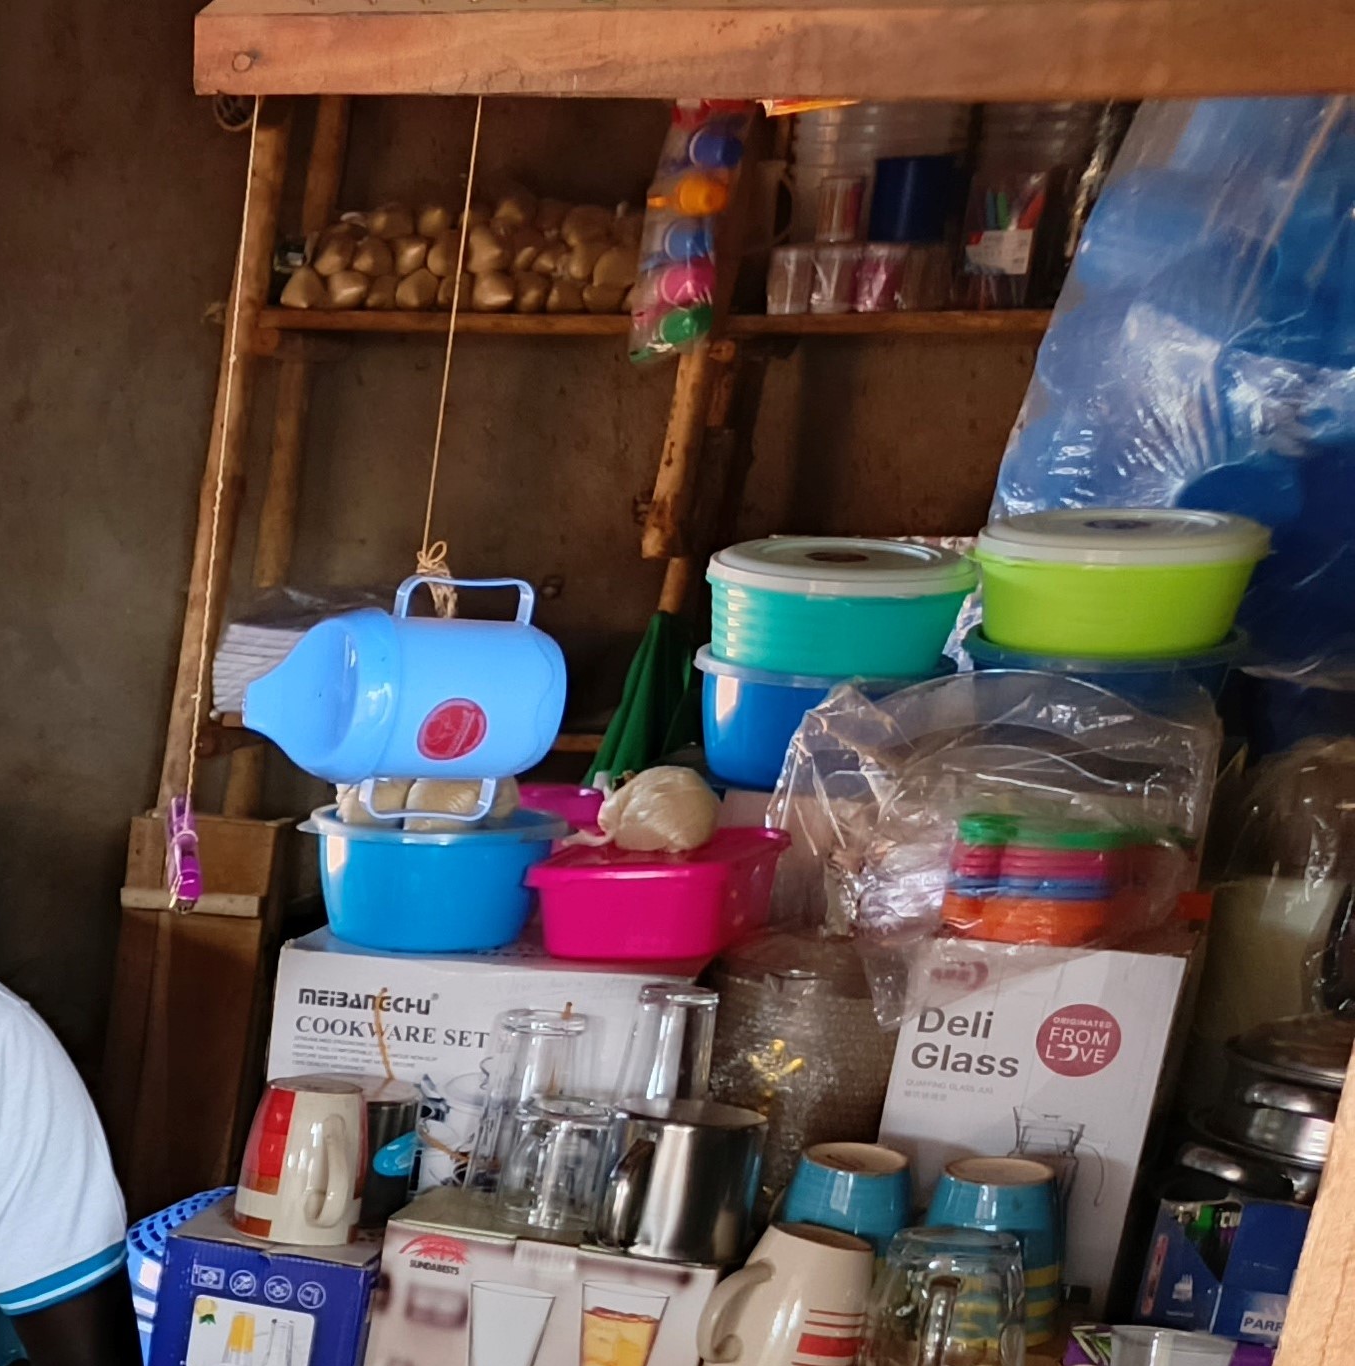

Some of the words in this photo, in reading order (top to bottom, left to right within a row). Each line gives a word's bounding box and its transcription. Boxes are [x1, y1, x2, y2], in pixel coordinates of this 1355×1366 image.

[294, 1015, 436, 1045] COOKWARE
[443, 1028, 490, 1049] SET
[917, 1006, 994, 1039] Deli
[1049, 1027, 1110, 1046] FROM
[1053, 1016, 1113, 1029] ORIGINATED
[911, 1042, 1020, 1079] Glass
